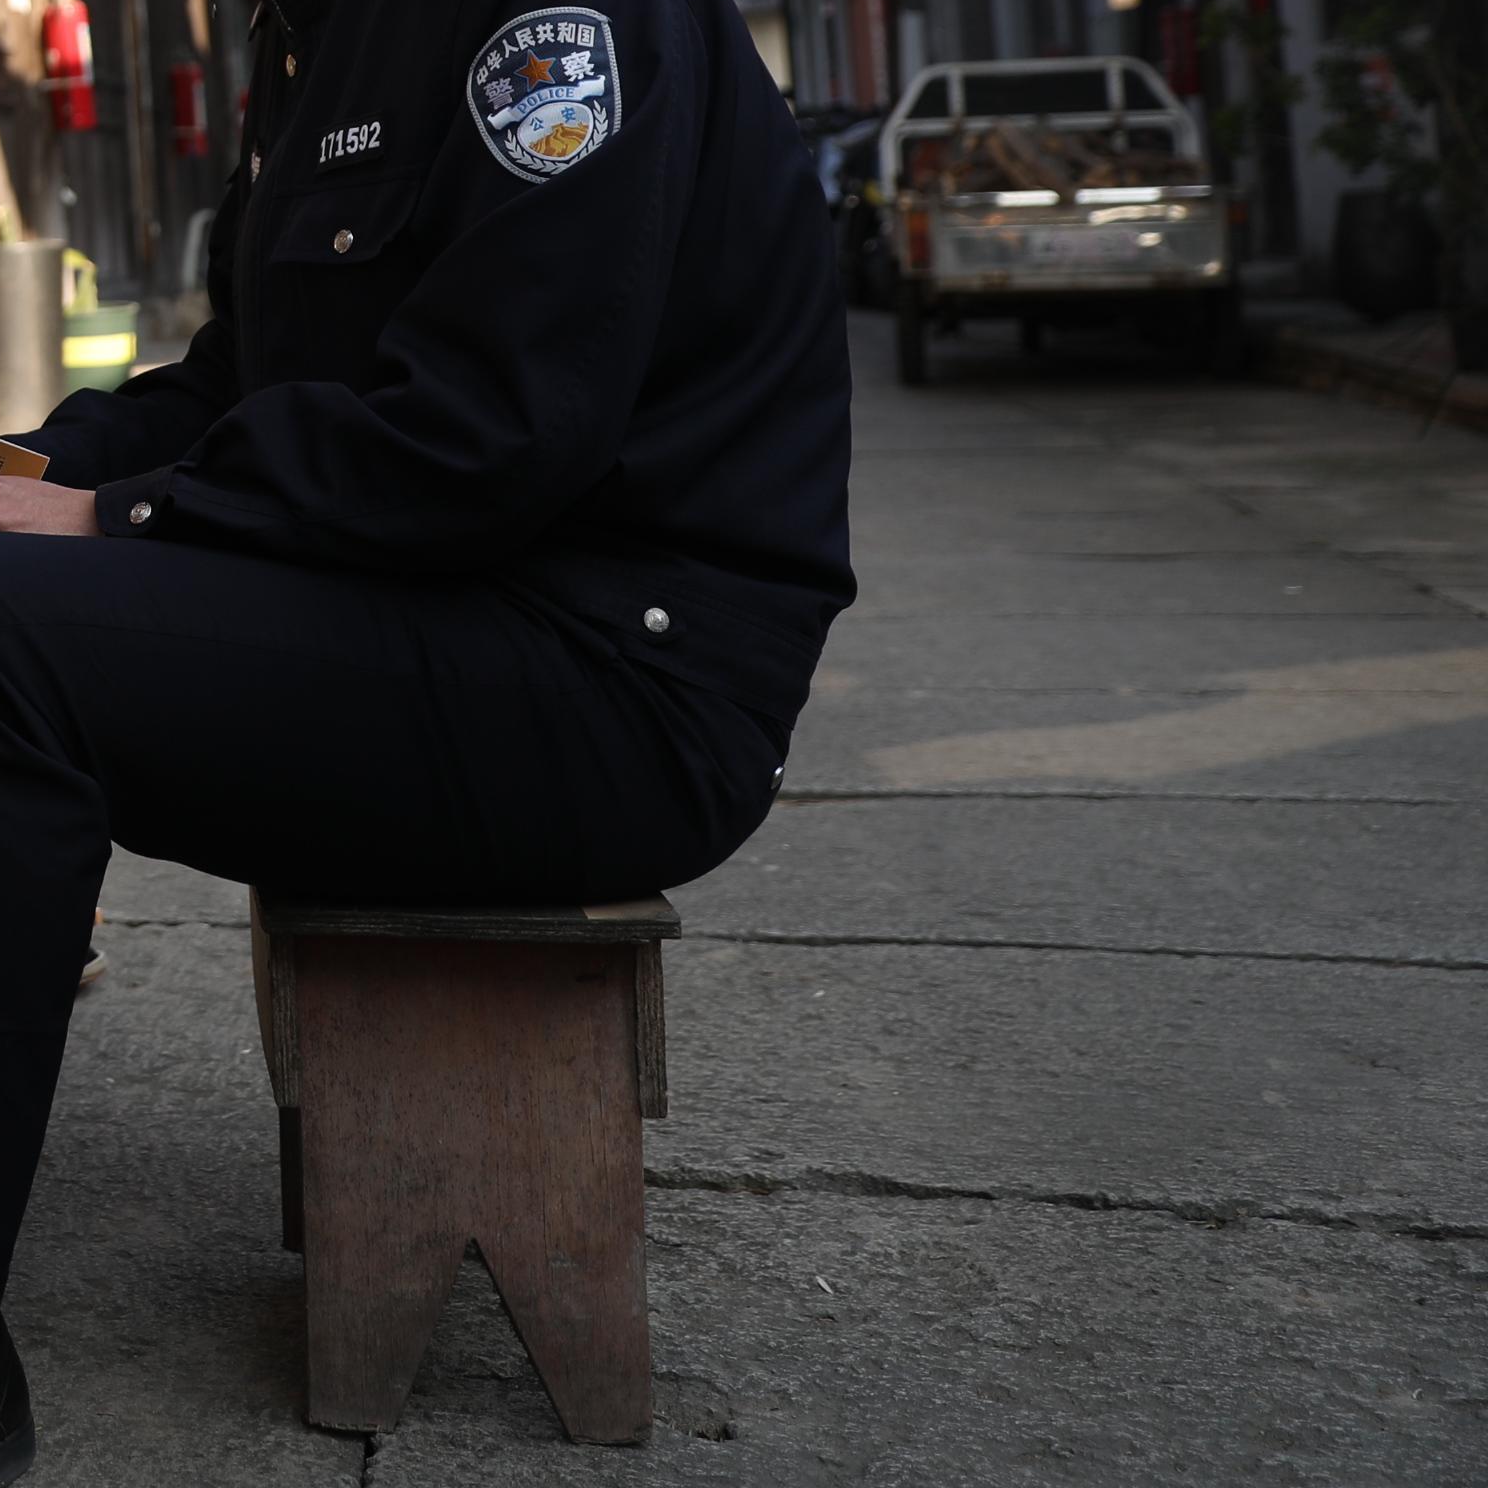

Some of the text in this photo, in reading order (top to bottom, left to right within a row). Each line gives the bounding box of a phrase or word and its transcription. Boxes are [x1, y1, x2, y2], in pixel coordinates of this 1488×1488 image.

[476, 22, 596, 86] 中华人民共和国
[516, 87, 575, 114] POLICE
[319, 121, 382, 163] 171592
